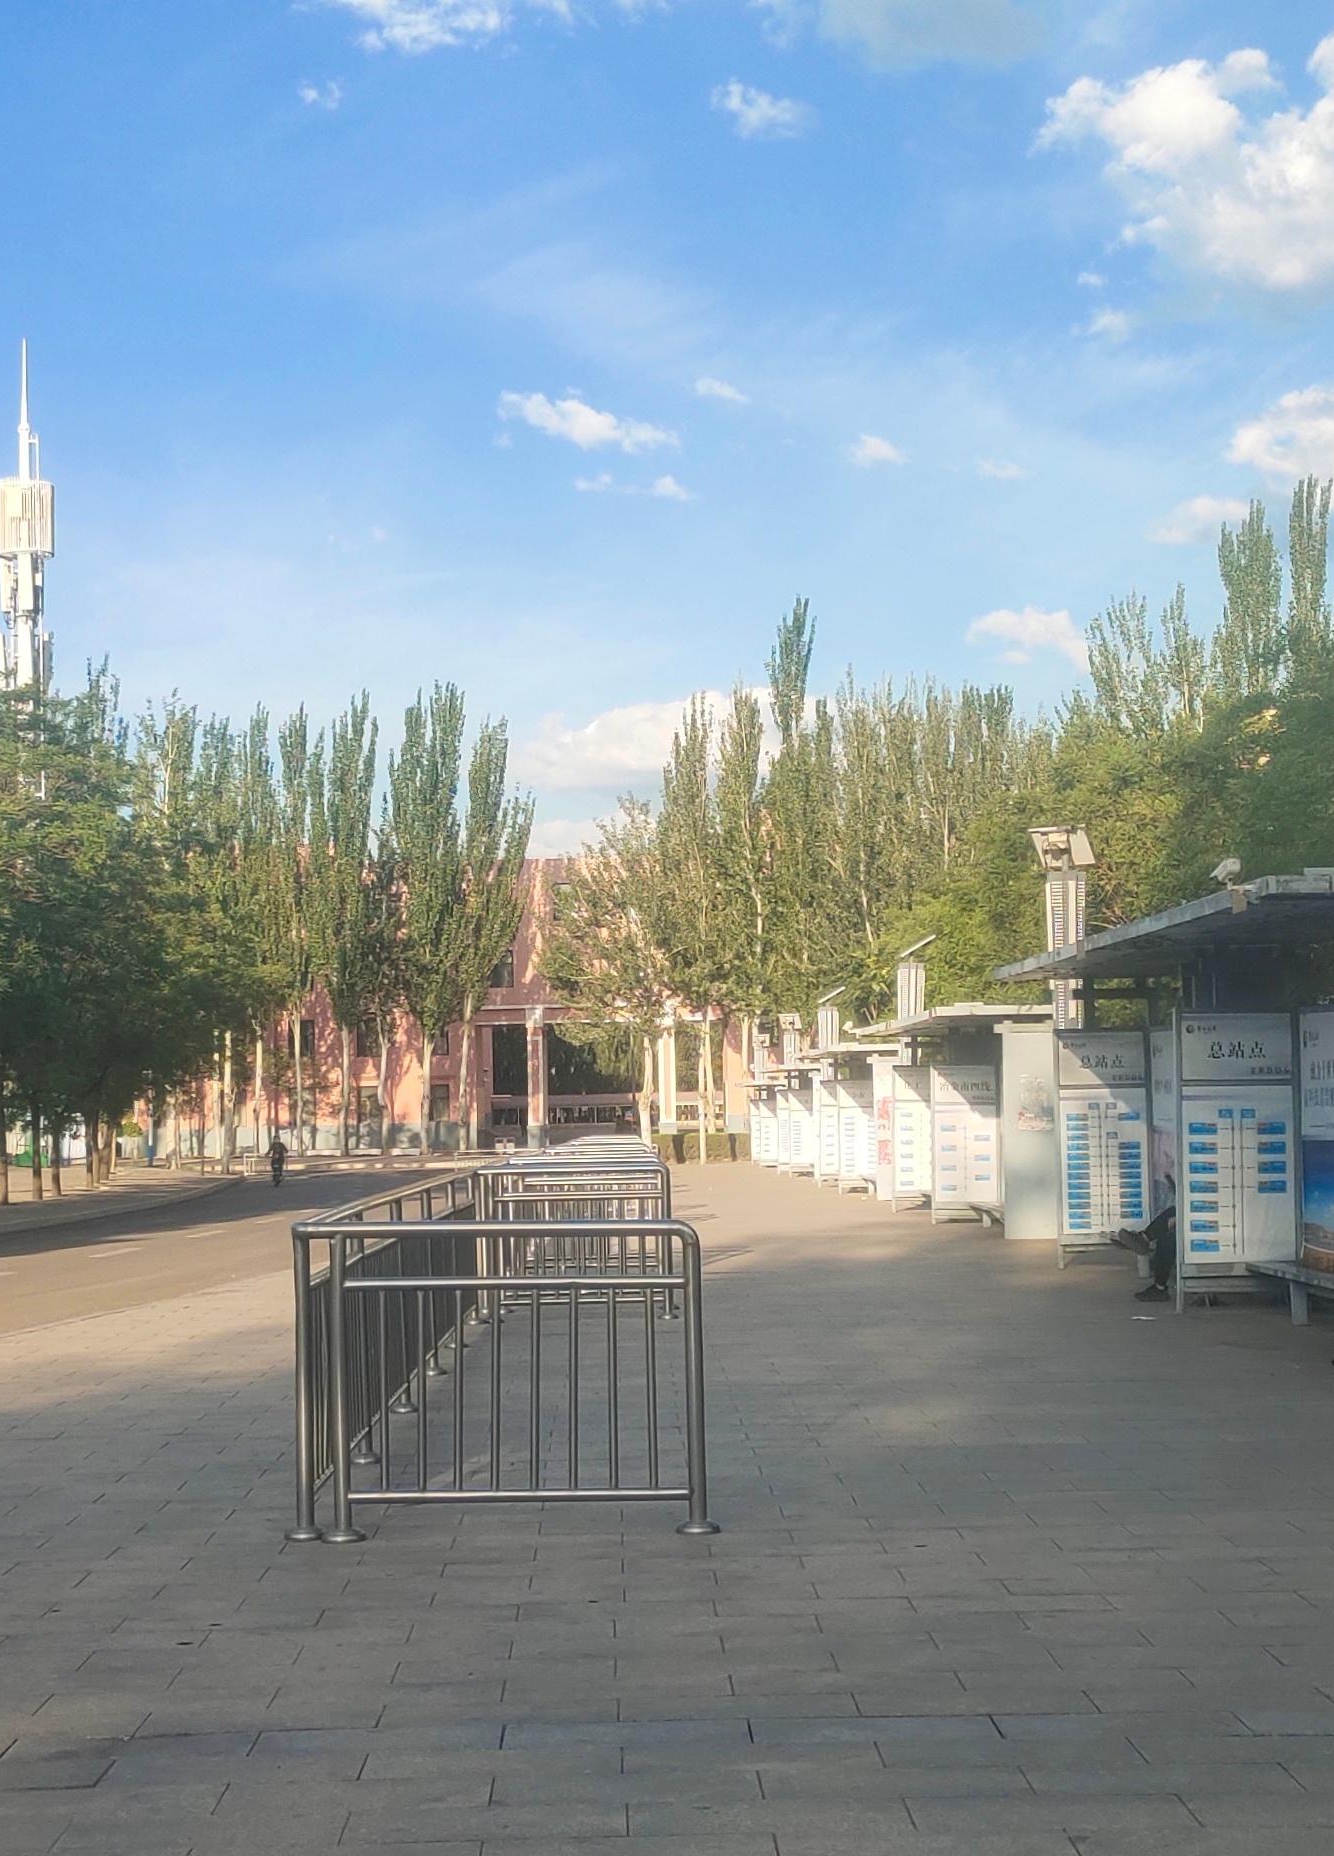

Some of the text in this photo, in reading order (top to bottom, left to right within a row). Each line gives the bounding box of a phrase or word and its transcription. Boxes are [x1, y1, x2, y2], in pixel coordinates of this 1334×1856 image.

[1207, 1041, 1266, 1059] 总站点
[1079, 1054, 1125, 1069] 总站点
